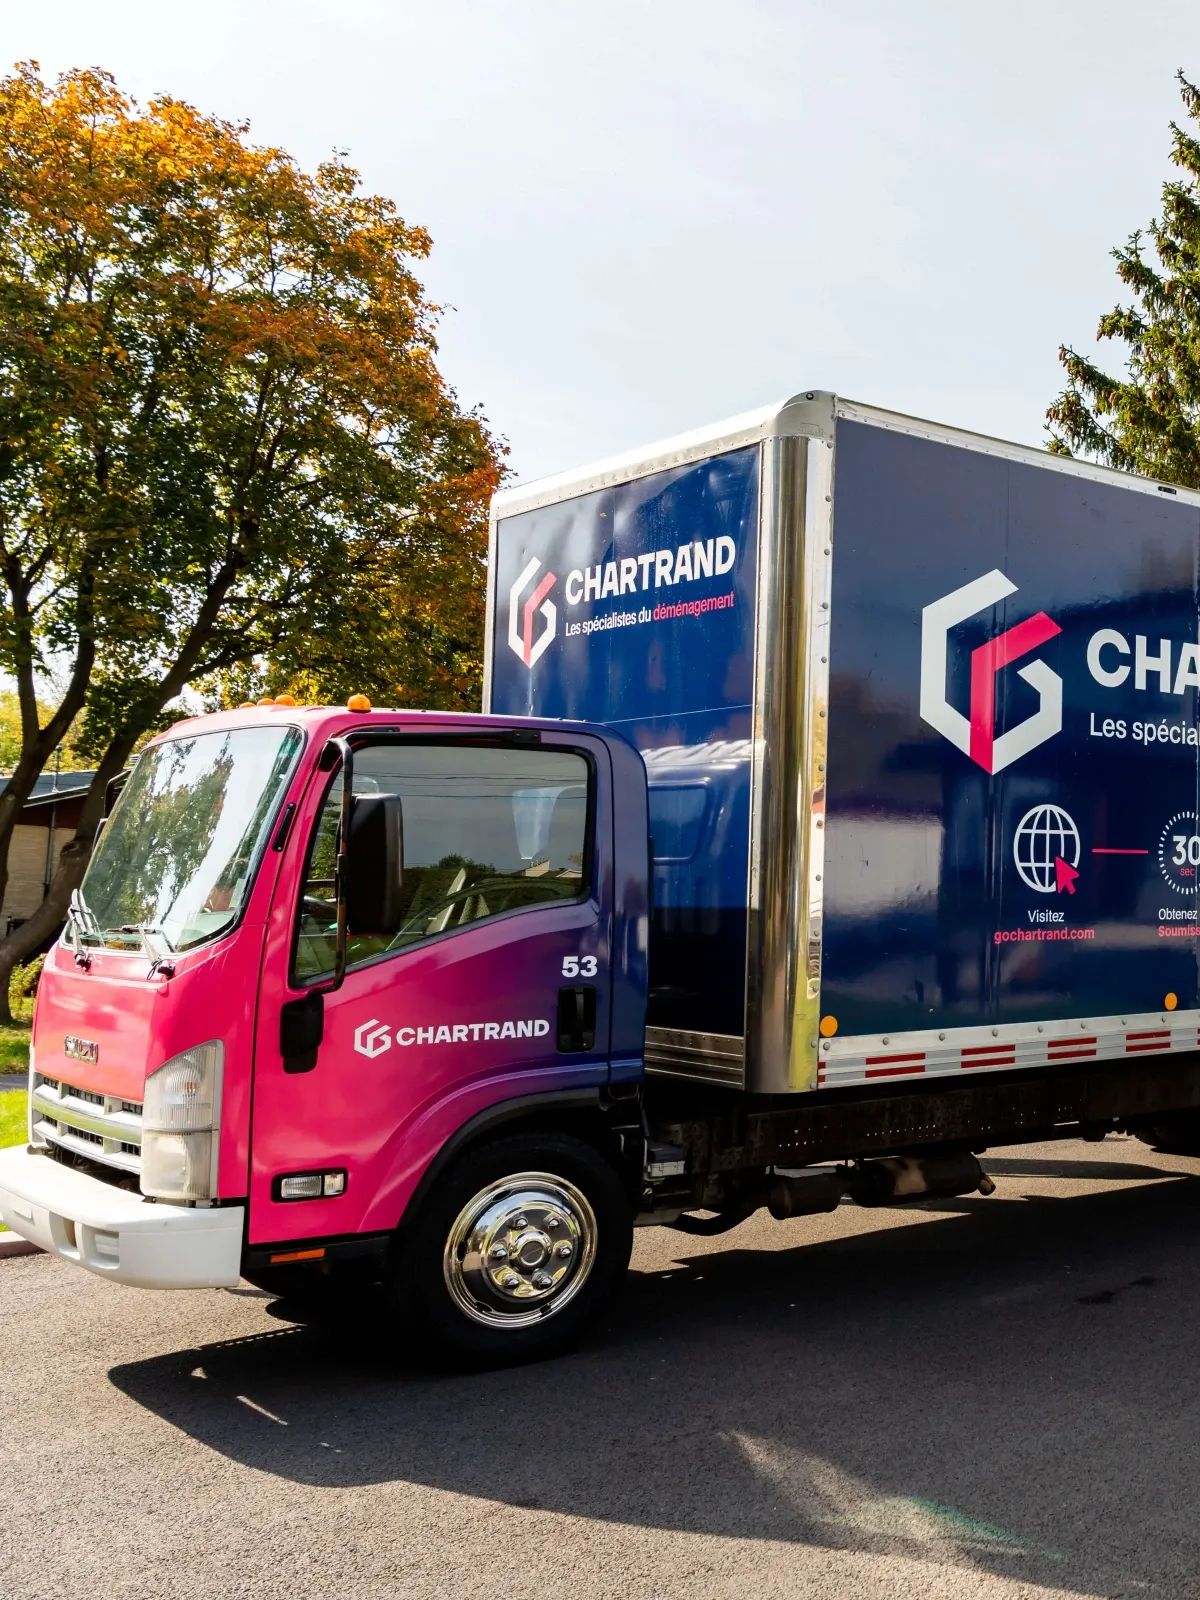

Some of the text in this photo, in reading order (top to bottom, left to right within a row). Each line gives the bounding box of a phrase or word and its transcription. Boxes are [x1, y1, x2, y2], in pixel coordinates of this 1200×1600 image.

[565, 535, 736, 606] CHARTRAND
[565, 591, 735, 637] Les spécialistes du déménagement
[1090, 712, 1127, 738] Les
[1180, 867, 1195, 877] sec
[1027, 909, 1065, 923] Visitez
[1158, 908, 1198, 921] Obtenez
[994, 927, 1095, 945] gochartrand.com
[561, 955, 598, 978] 53
[396, 1019, 550, 1046] CHARTRAND
